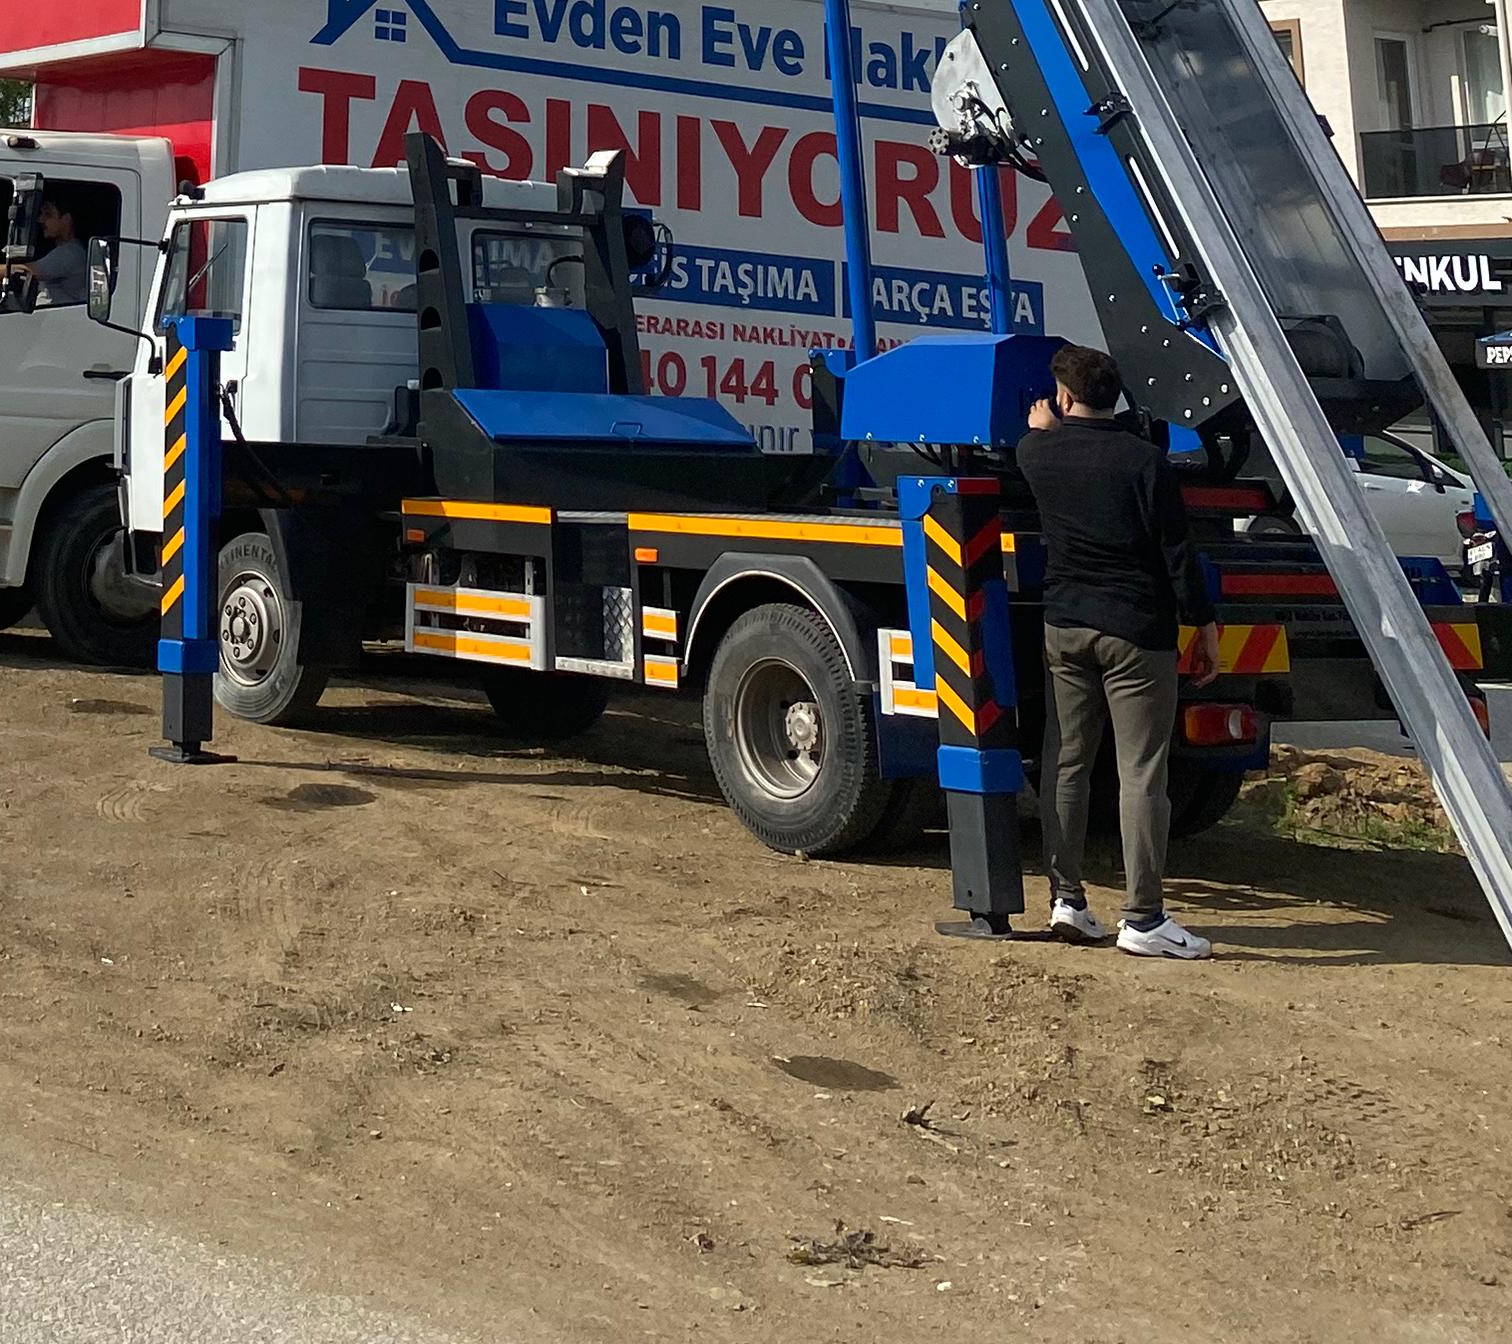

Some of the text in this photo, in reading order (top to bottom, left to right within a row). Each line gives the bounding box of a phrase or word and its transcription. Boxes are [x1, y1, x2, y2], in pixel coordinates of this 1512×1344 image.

[701, 5, 805, 77] Eve
[695, 258, 819, 305] TAŞIMA
[872, 277, 954, 323] ARÇA
[961, 286, 1036, 329] EŞA
[1394, 254, 1502, 292] NKUL
[635, 314, 725, 341] ERARASI
[732, 324, 836, 350] NAKLİYAT
[701, 355, 779, 406] 144
